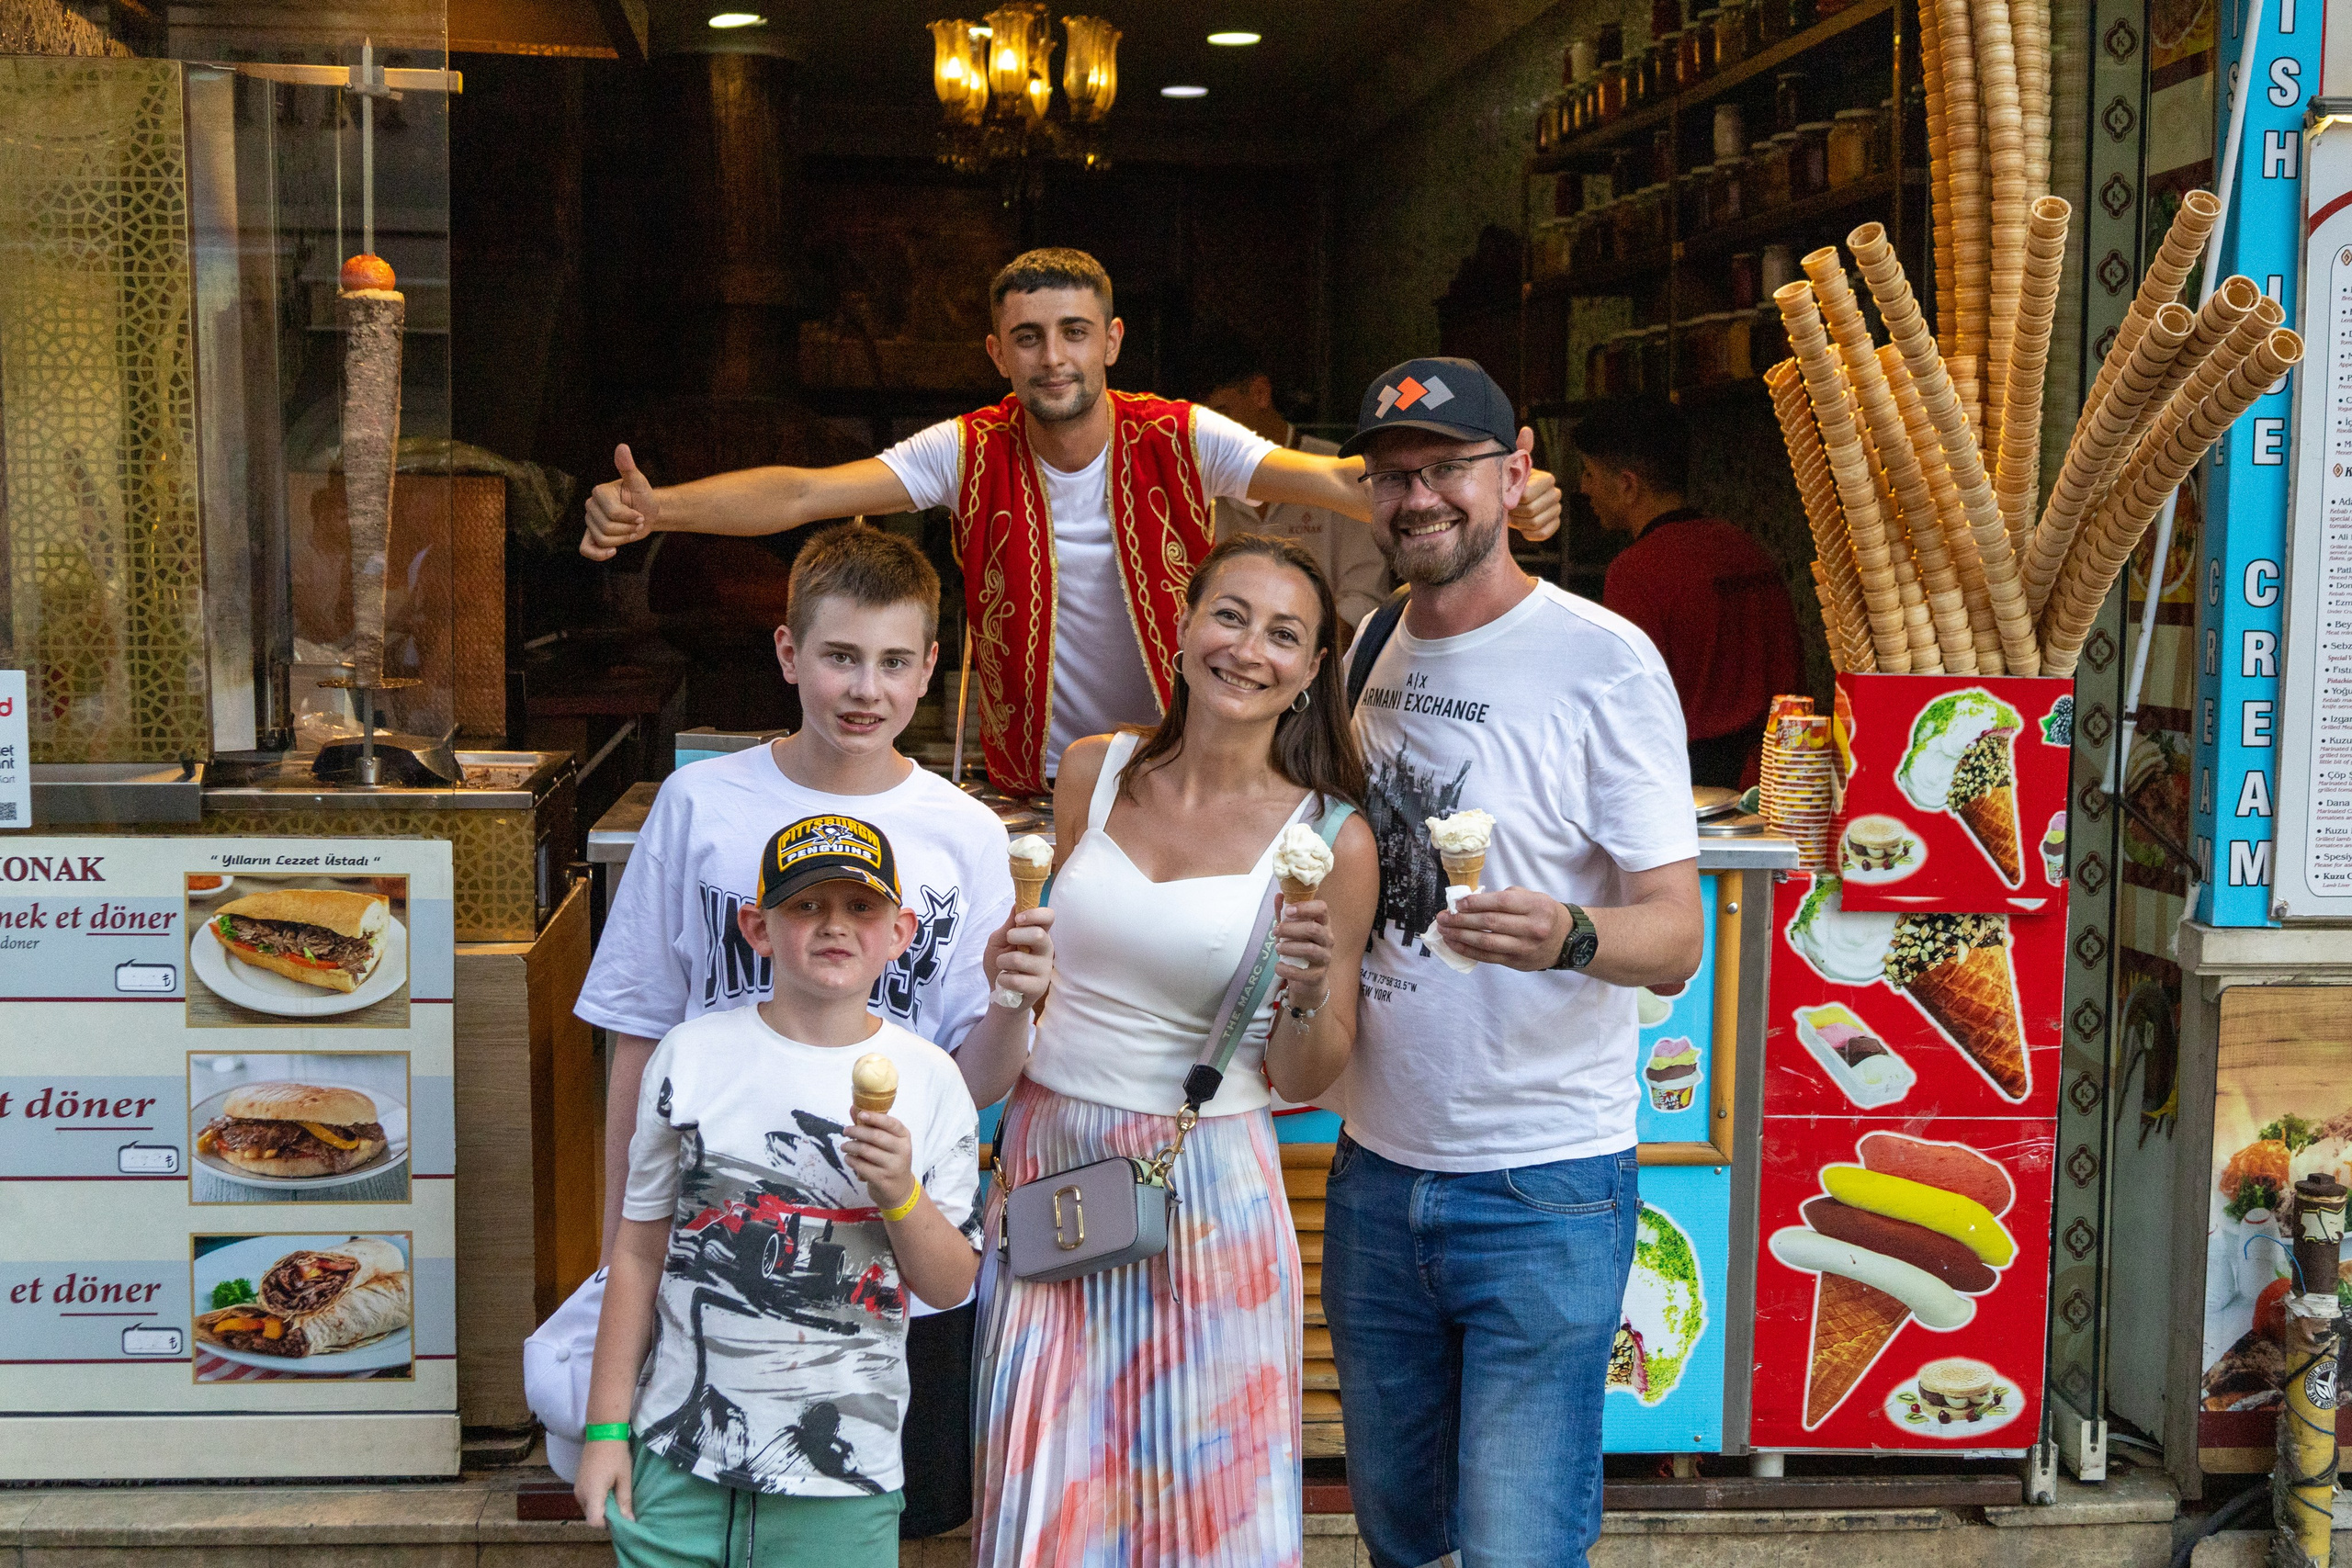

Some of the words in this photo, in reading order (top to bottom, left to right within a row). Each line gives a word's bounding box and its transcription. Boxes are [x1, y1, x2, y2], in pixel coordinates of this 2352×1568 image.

[1361, 687, 1403, 710] ARMANI
[1403, 693, 1490, 724] EXCHANGE
[0, 744, 15, 756] et
[0, 757, 16, 769] nt
[221, 854, 271, 867] Yılların
[275, 854, 320, 865] Lezzet
[324, 852, 369, 866] Üstadı
[786, 843, 872, 863] PENGUINS
[0, 856, 106, 882] ONAK
[2323, 872, 2346, 880] Kuzu
[55, 905, 83, 930] et
[89, 902, 177, 930] döner
[0, 935, 40, 950] doner
[1221, 1010, 1242, 1041] THE
[1237, 964, 1263, 1009] MARC
[1373, 987, 1393, 1003] YORK
[25, 1088, 156, 1119] döner
[10, 1279, 44, 1304] et
[53, 1273, 162, 1304] döner
